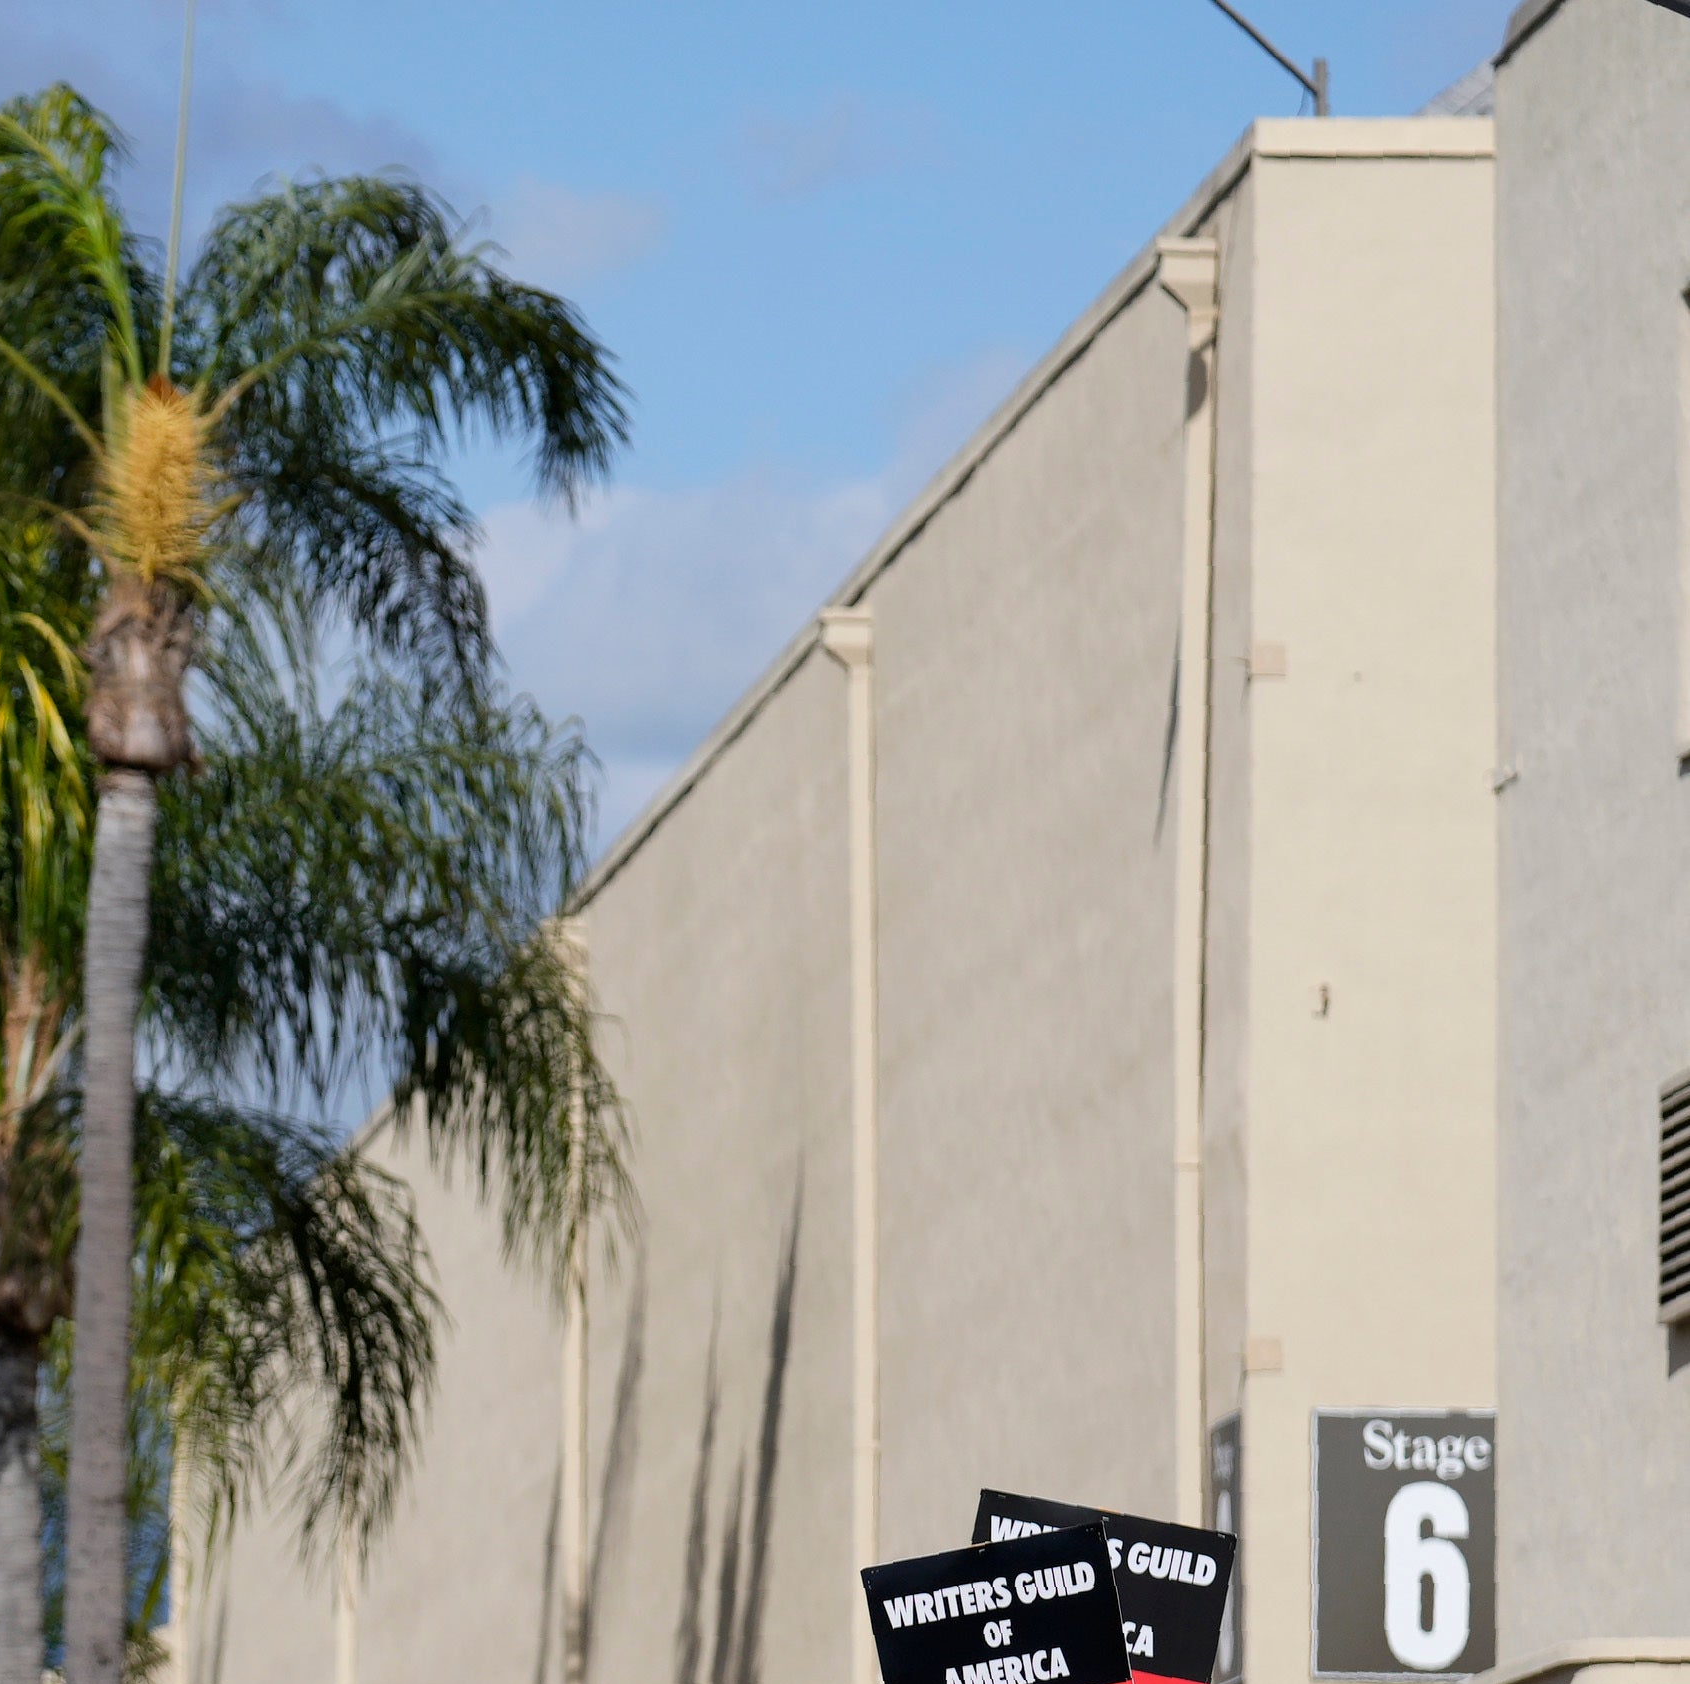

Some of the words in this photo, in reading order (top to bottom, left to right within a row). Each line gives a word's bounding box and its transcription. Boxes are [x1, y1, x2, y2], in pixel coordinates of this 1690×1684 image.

[1362, 1419, 1492, 1479] Stage
[1127, 1541, 1217, 1588] GUILD
[1384, 1480, 1470, 1671] 6
[884, 1577, 1012, 1630] WRITERS
[1015, 1561, 1096, 1605] GUILD
[983, 1618, 1014, 1648] OF
